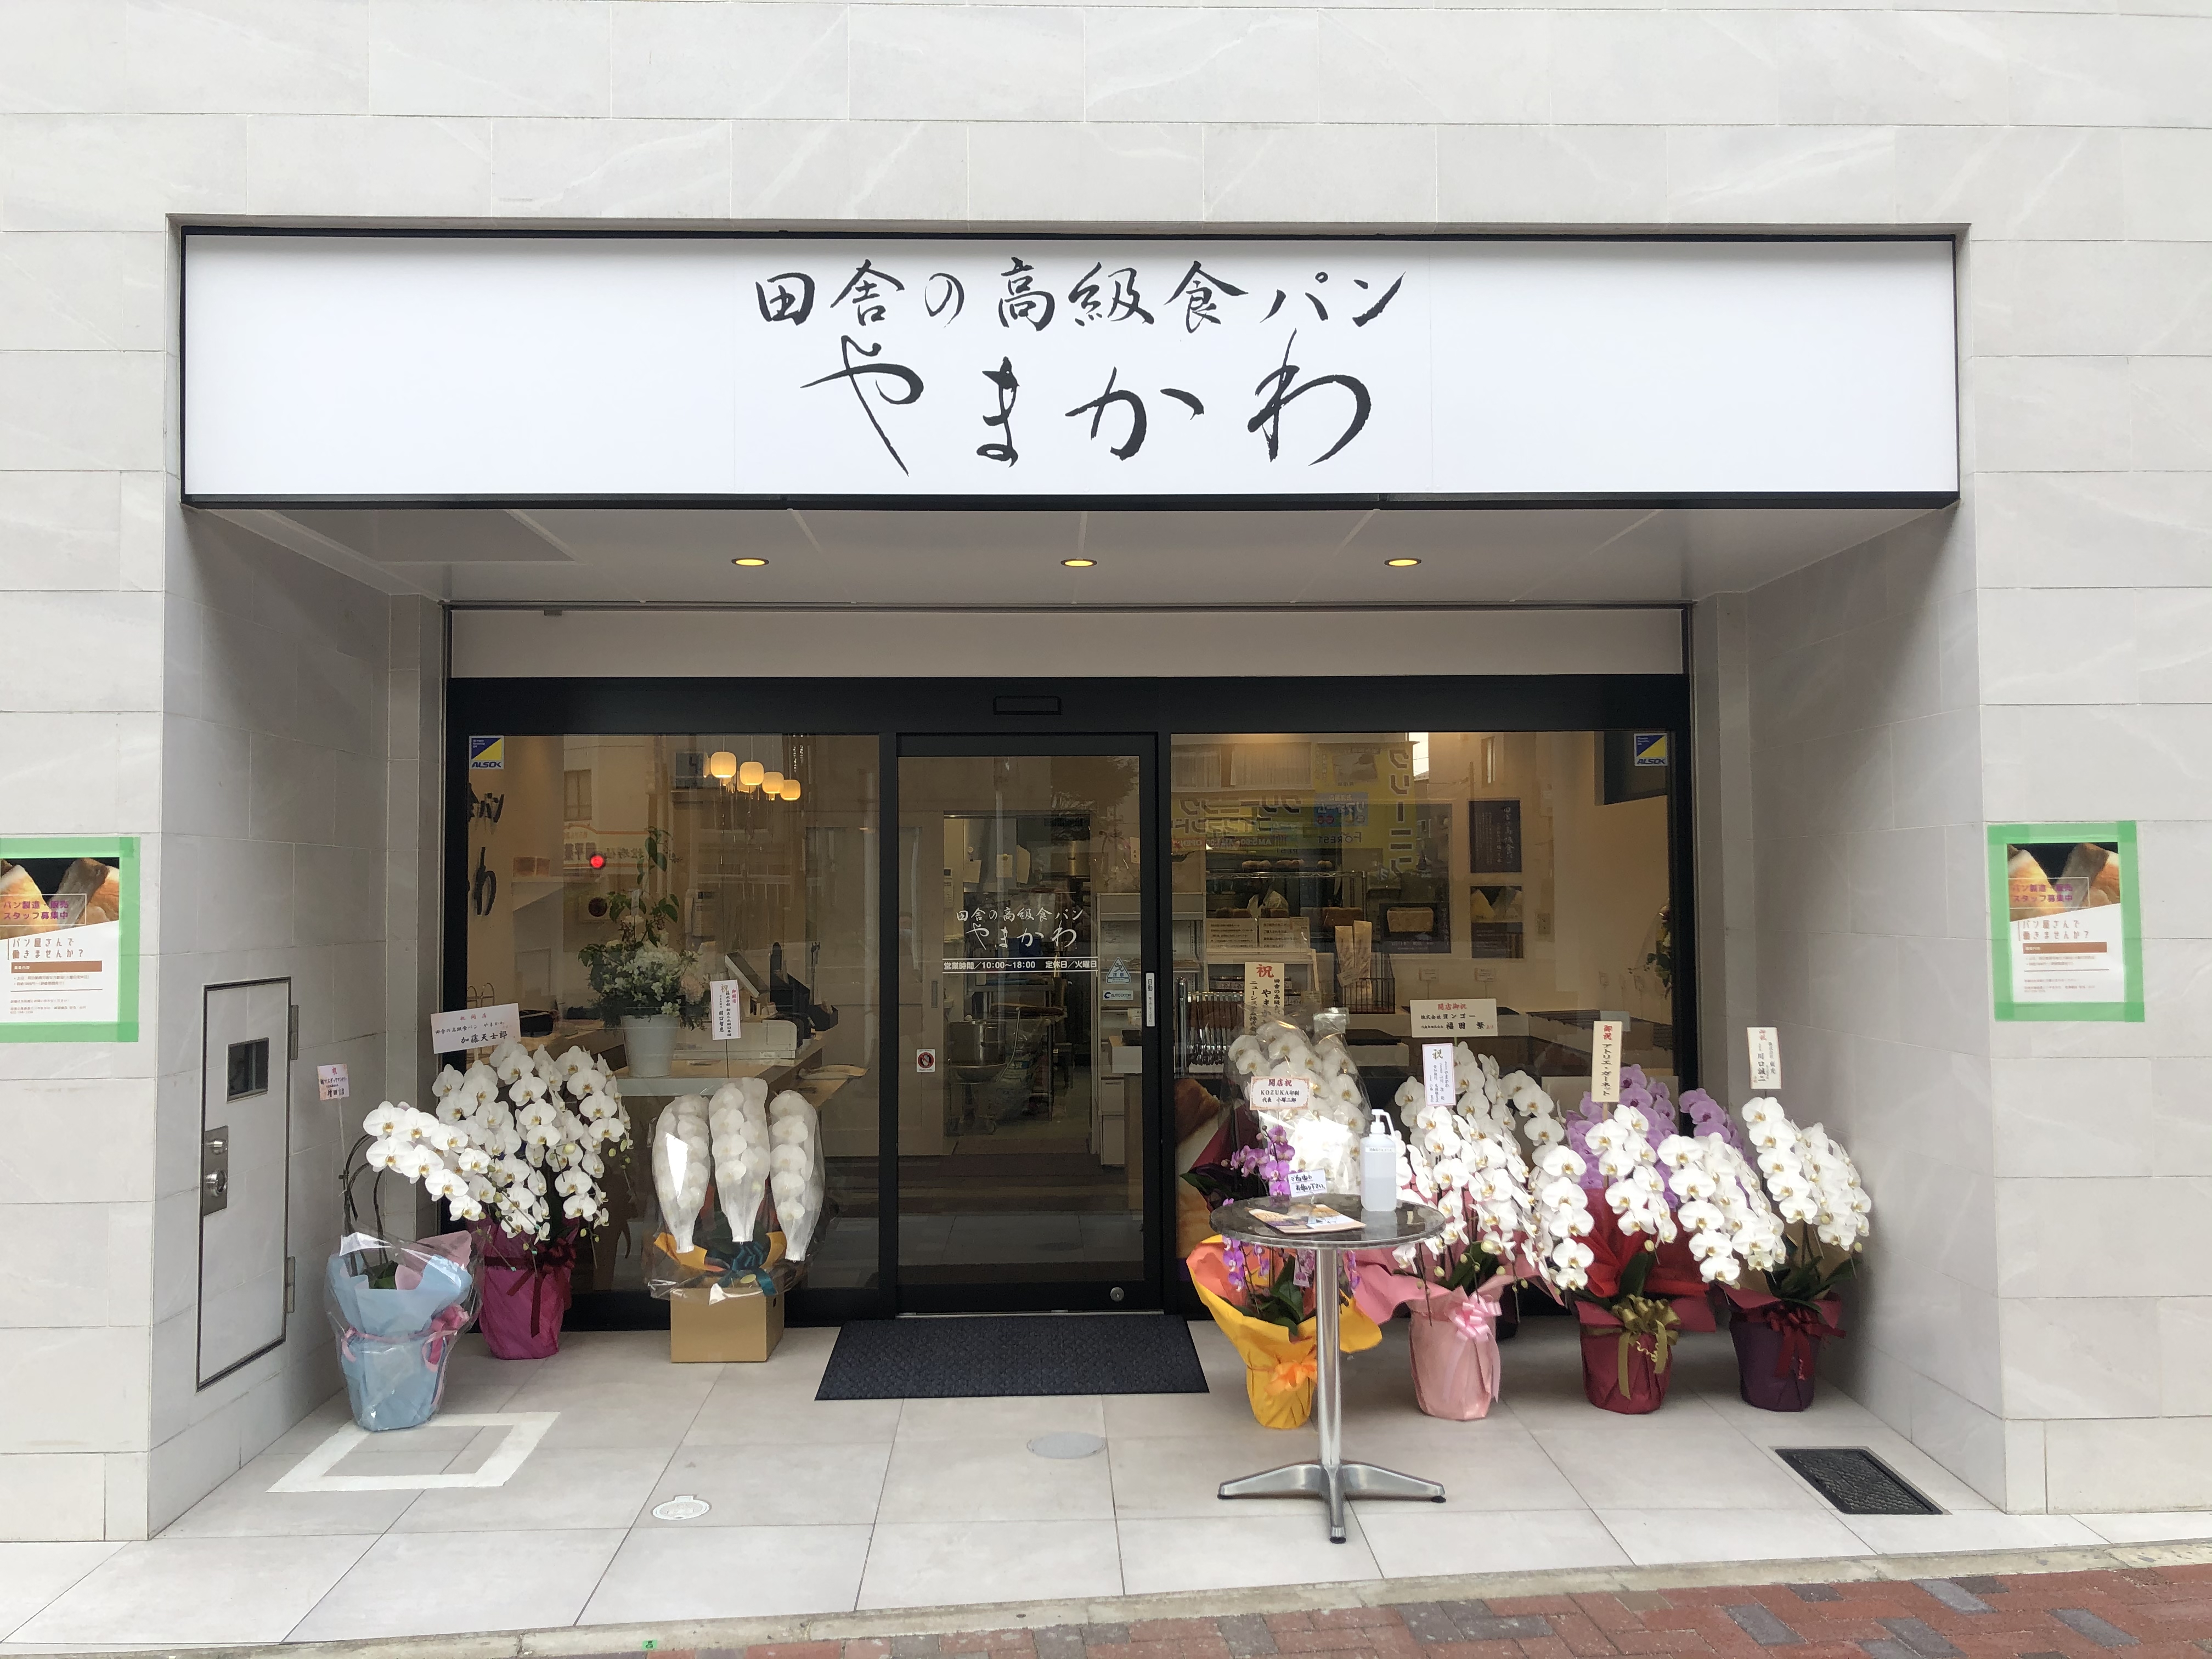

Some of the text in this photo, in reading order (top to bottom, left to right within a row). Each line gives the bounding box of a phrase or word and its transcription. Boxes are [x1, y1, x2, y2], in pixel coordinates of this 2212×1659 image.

[755, 257, 1405, 331] 田舎の高級食パン
[800, 329, 1372, 476] やまかわ
[3, 911, 69, 920] スタッフ募集中
[956, 907, 1084, 922] 田舎の高級食パン
[966, 921, 1077, 950] やまかわ
[13, 938, 74, 947] パン屋さんで
[1256, 964, 1274, 978] 祝
[721, 984, 728, 992] 祝
[1432, 1049, 1443, 1060] 祝
[1268, 1078, 1292, 1086] 開店祝
